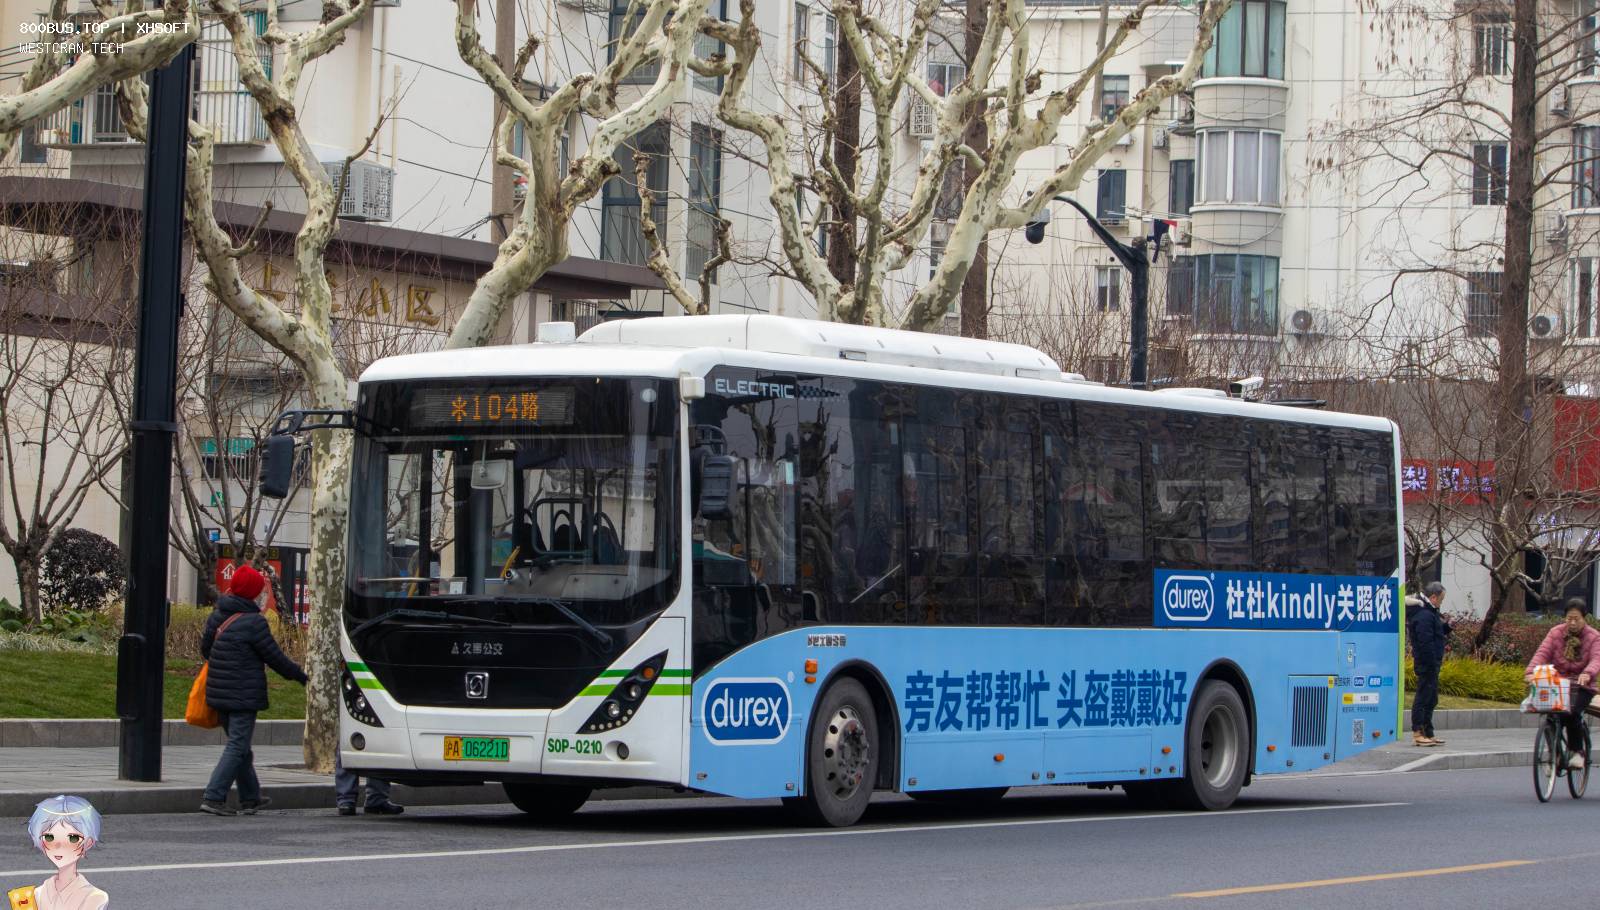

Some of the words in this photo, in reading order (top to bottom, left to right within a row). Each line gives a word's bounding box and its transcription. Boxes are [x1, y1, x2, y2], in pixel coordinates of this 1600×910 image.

[252, 260, 441, 326] 上小区
[715, 378, 794, 399] ELECTRIC
[1168, 582, 1209, 613] durex
[1226, 579, 1392, 629] 杜杜kindly关照侬
[711, 687, 783, 732] durex
[904, 669, 1050, 732] 旁友帮帮忙
[1056, 669, 1187, 729] 头盔戴戴好
